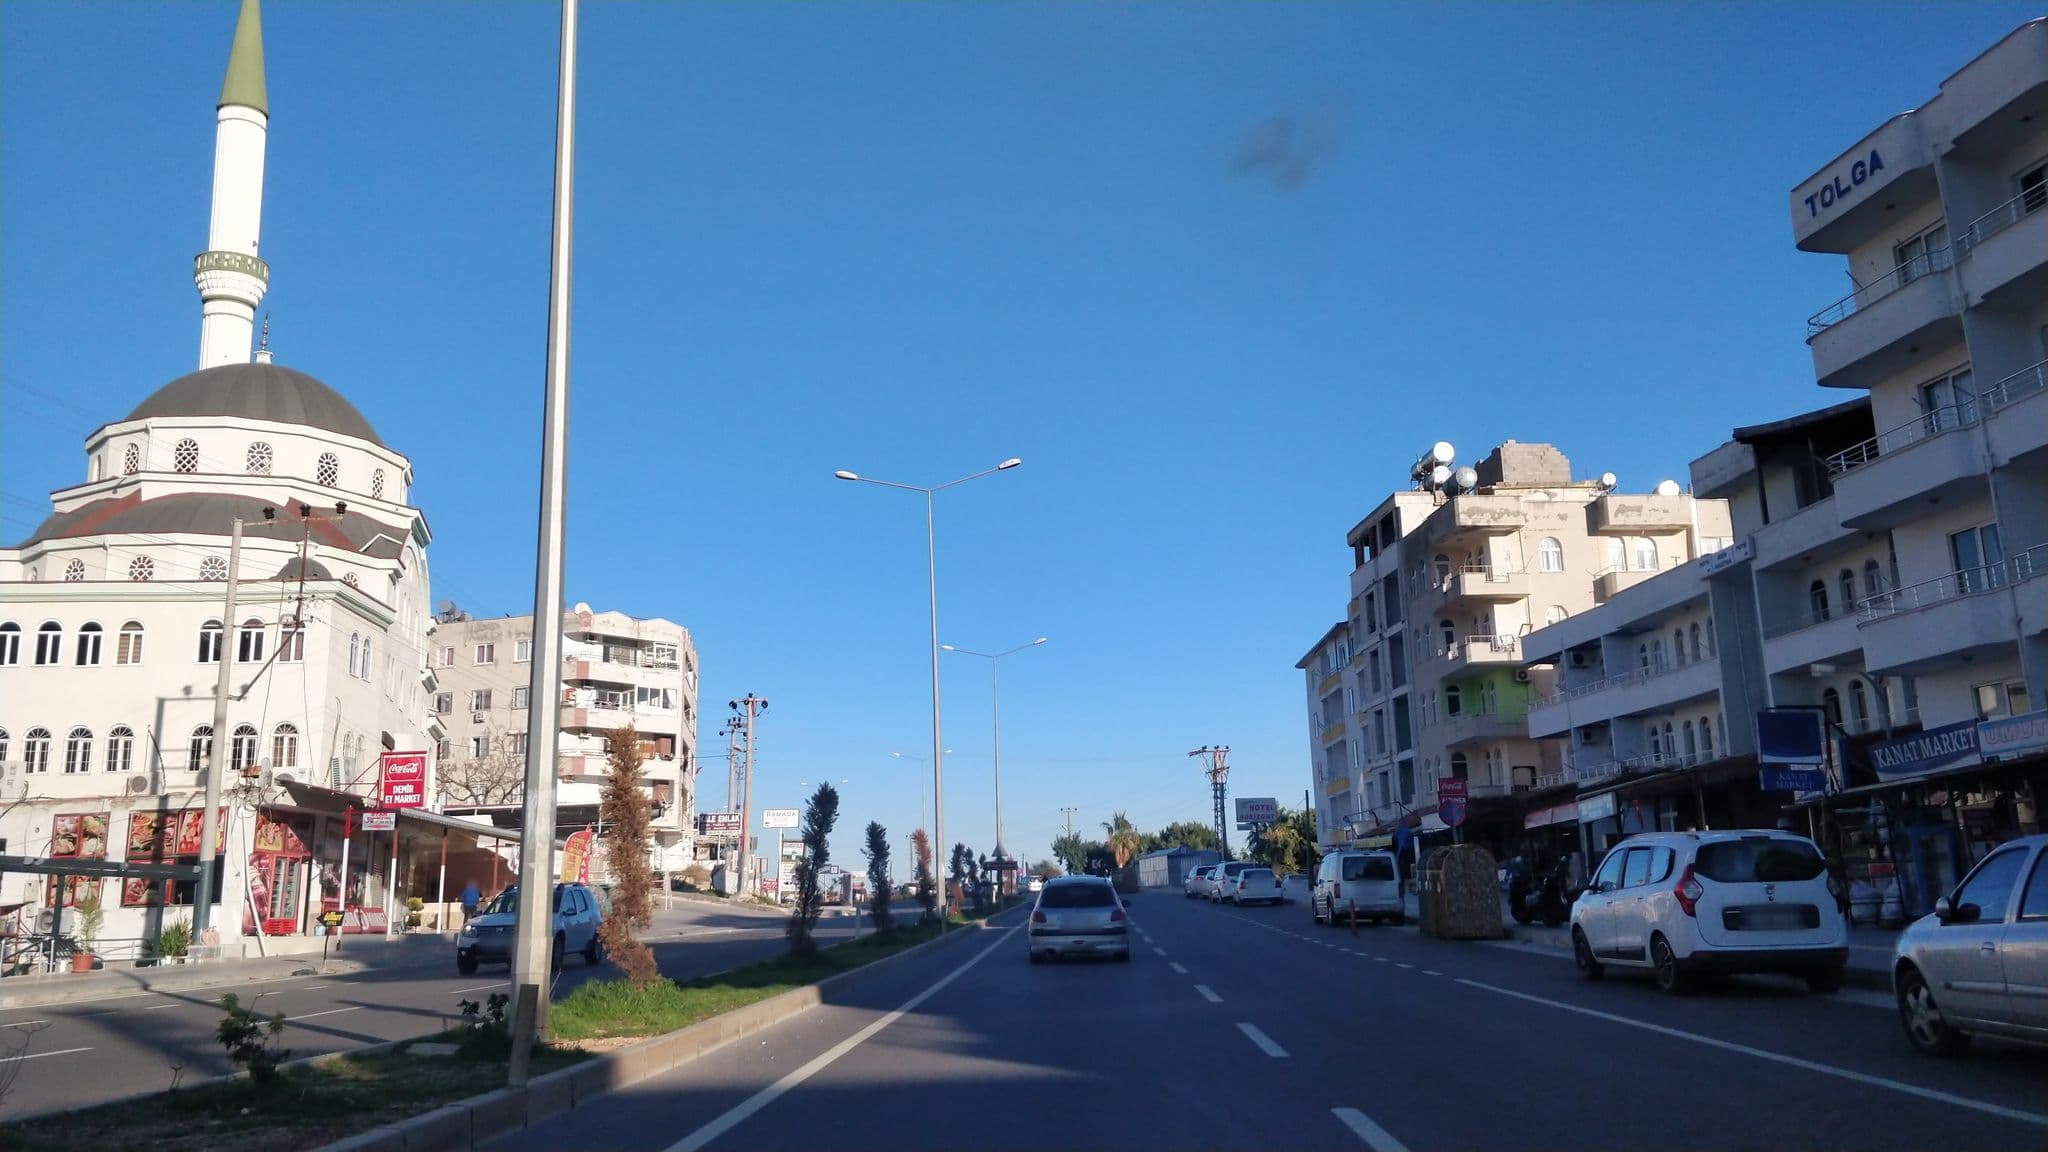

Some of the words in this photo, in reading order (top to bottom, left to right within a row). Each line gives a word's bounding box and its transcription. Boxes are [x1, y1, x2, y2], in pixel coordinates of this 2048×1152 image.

[1804, 149, 1885, 217] TOLGA
[1875, 741, 1921, 768] KANAT
[1919, 727, 1976, 759] MARKET
[388, 762, 419, 774] Coca-Cola
[385, 795, 393, 804] ET
[394, 794, 420, 803] MARKET
[718, 813, 740, 822] EMLAK
